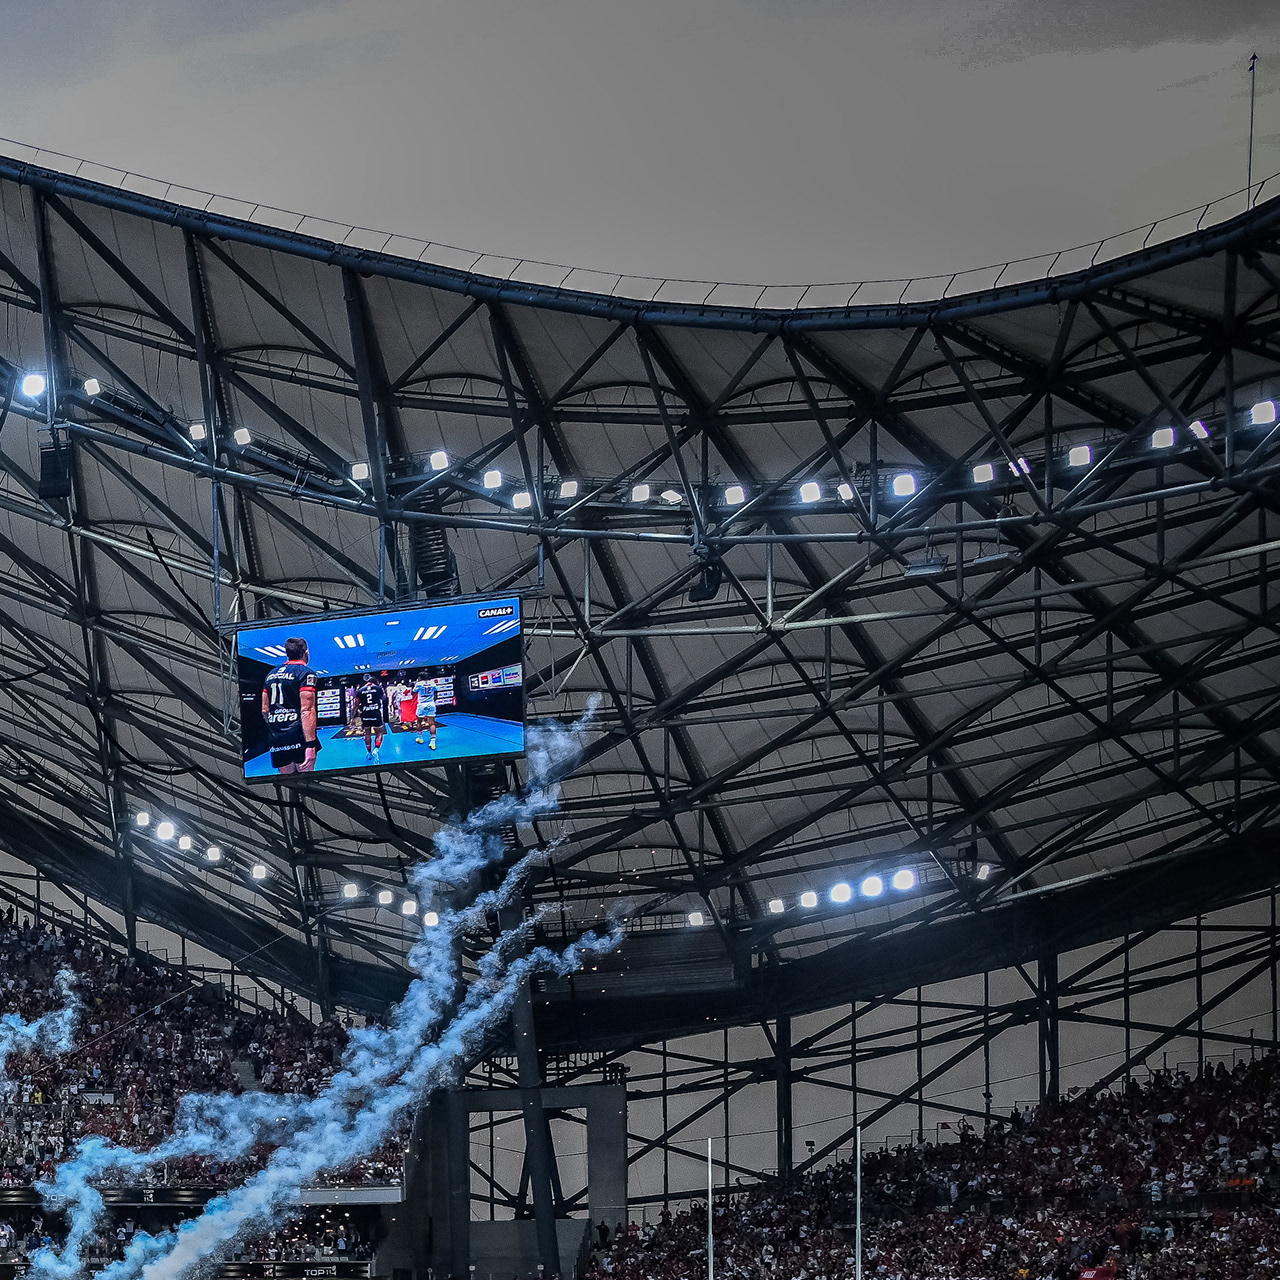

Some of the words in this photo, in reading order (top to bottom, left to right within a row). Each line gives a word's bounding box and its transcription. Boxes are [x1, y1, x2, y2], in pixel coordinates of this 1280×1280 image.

[479, 607, 513, 617] CANAL+
[271, 683, 284, 705] 11
[267, 712, 298, 723] arera
